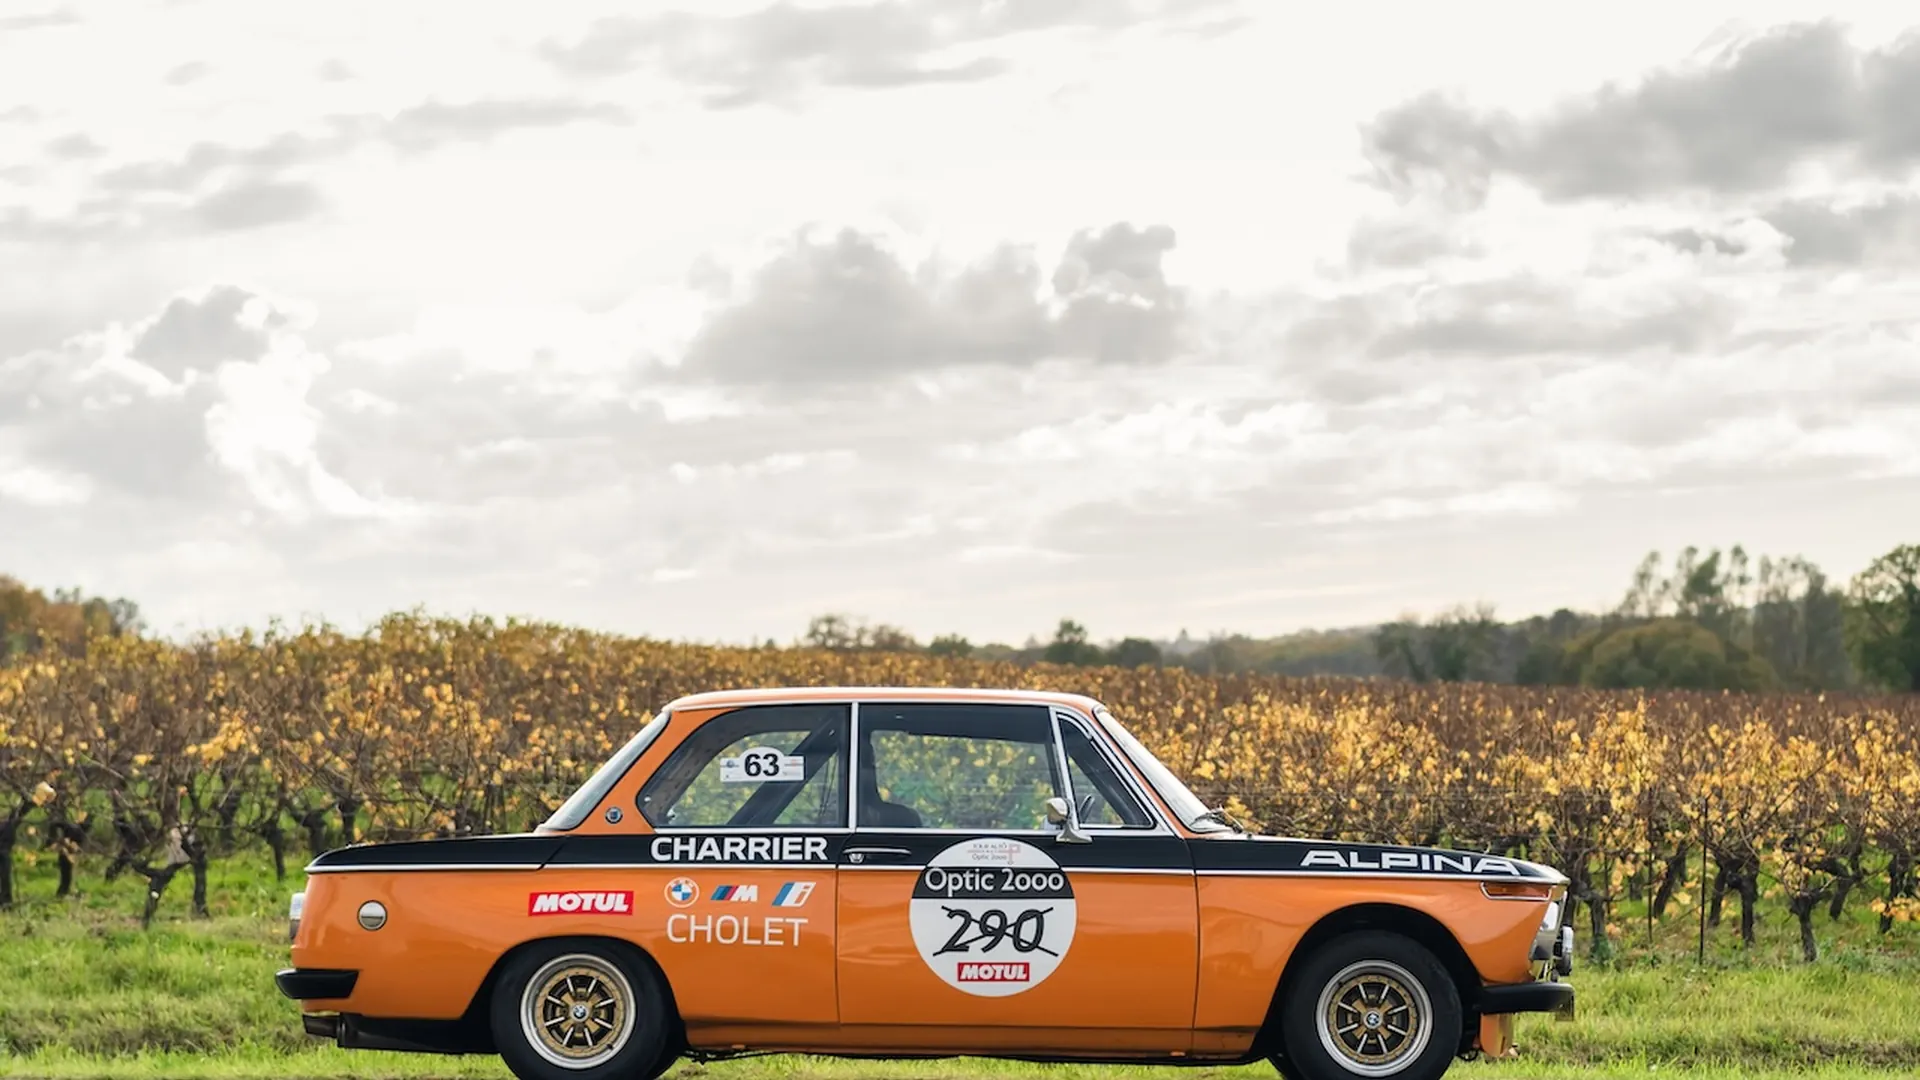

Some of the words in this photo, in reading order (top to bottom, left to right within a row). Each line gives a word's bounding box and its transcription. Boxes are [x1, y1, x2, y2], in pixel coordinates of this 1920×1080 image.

[744, 753, 780, 777] 63
[651, 837, 828, 861] CHARRIER
[1300, 850, 1521, 876] ALPINA
[925, 867, 995, 897] Optic
[1001, 868, 1064, 891] 2000
[532, 892, 631, 913] MOTUL
[667, 914, 808, 946] CHOLET
[941, 909, 1044, 953] 290
[960, 964, 1028, 980] MOTUL
